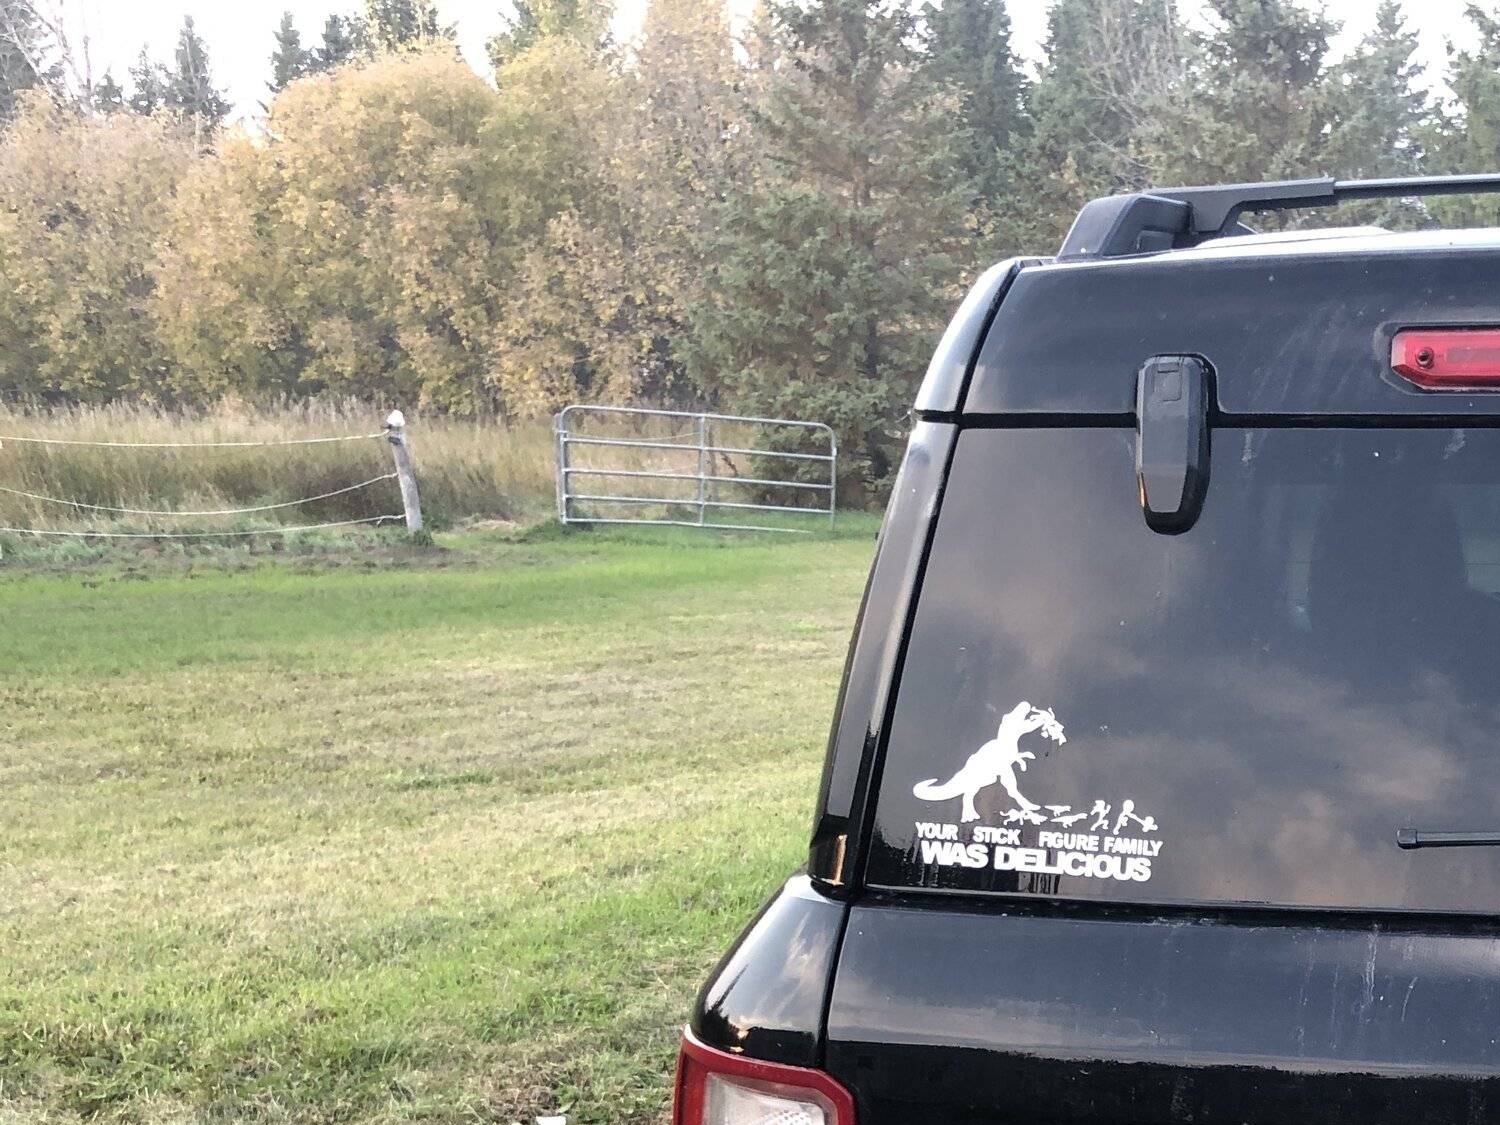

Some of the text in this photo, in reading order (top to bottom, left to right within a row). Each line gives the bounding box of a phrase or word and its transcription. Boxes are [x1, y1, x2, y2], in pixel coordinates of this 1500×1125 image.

[915, 821, 1163, 857] YOUR STICK FIGURE FAMILY
[921, 841, 1151, 882] WAS DELICIOUS
